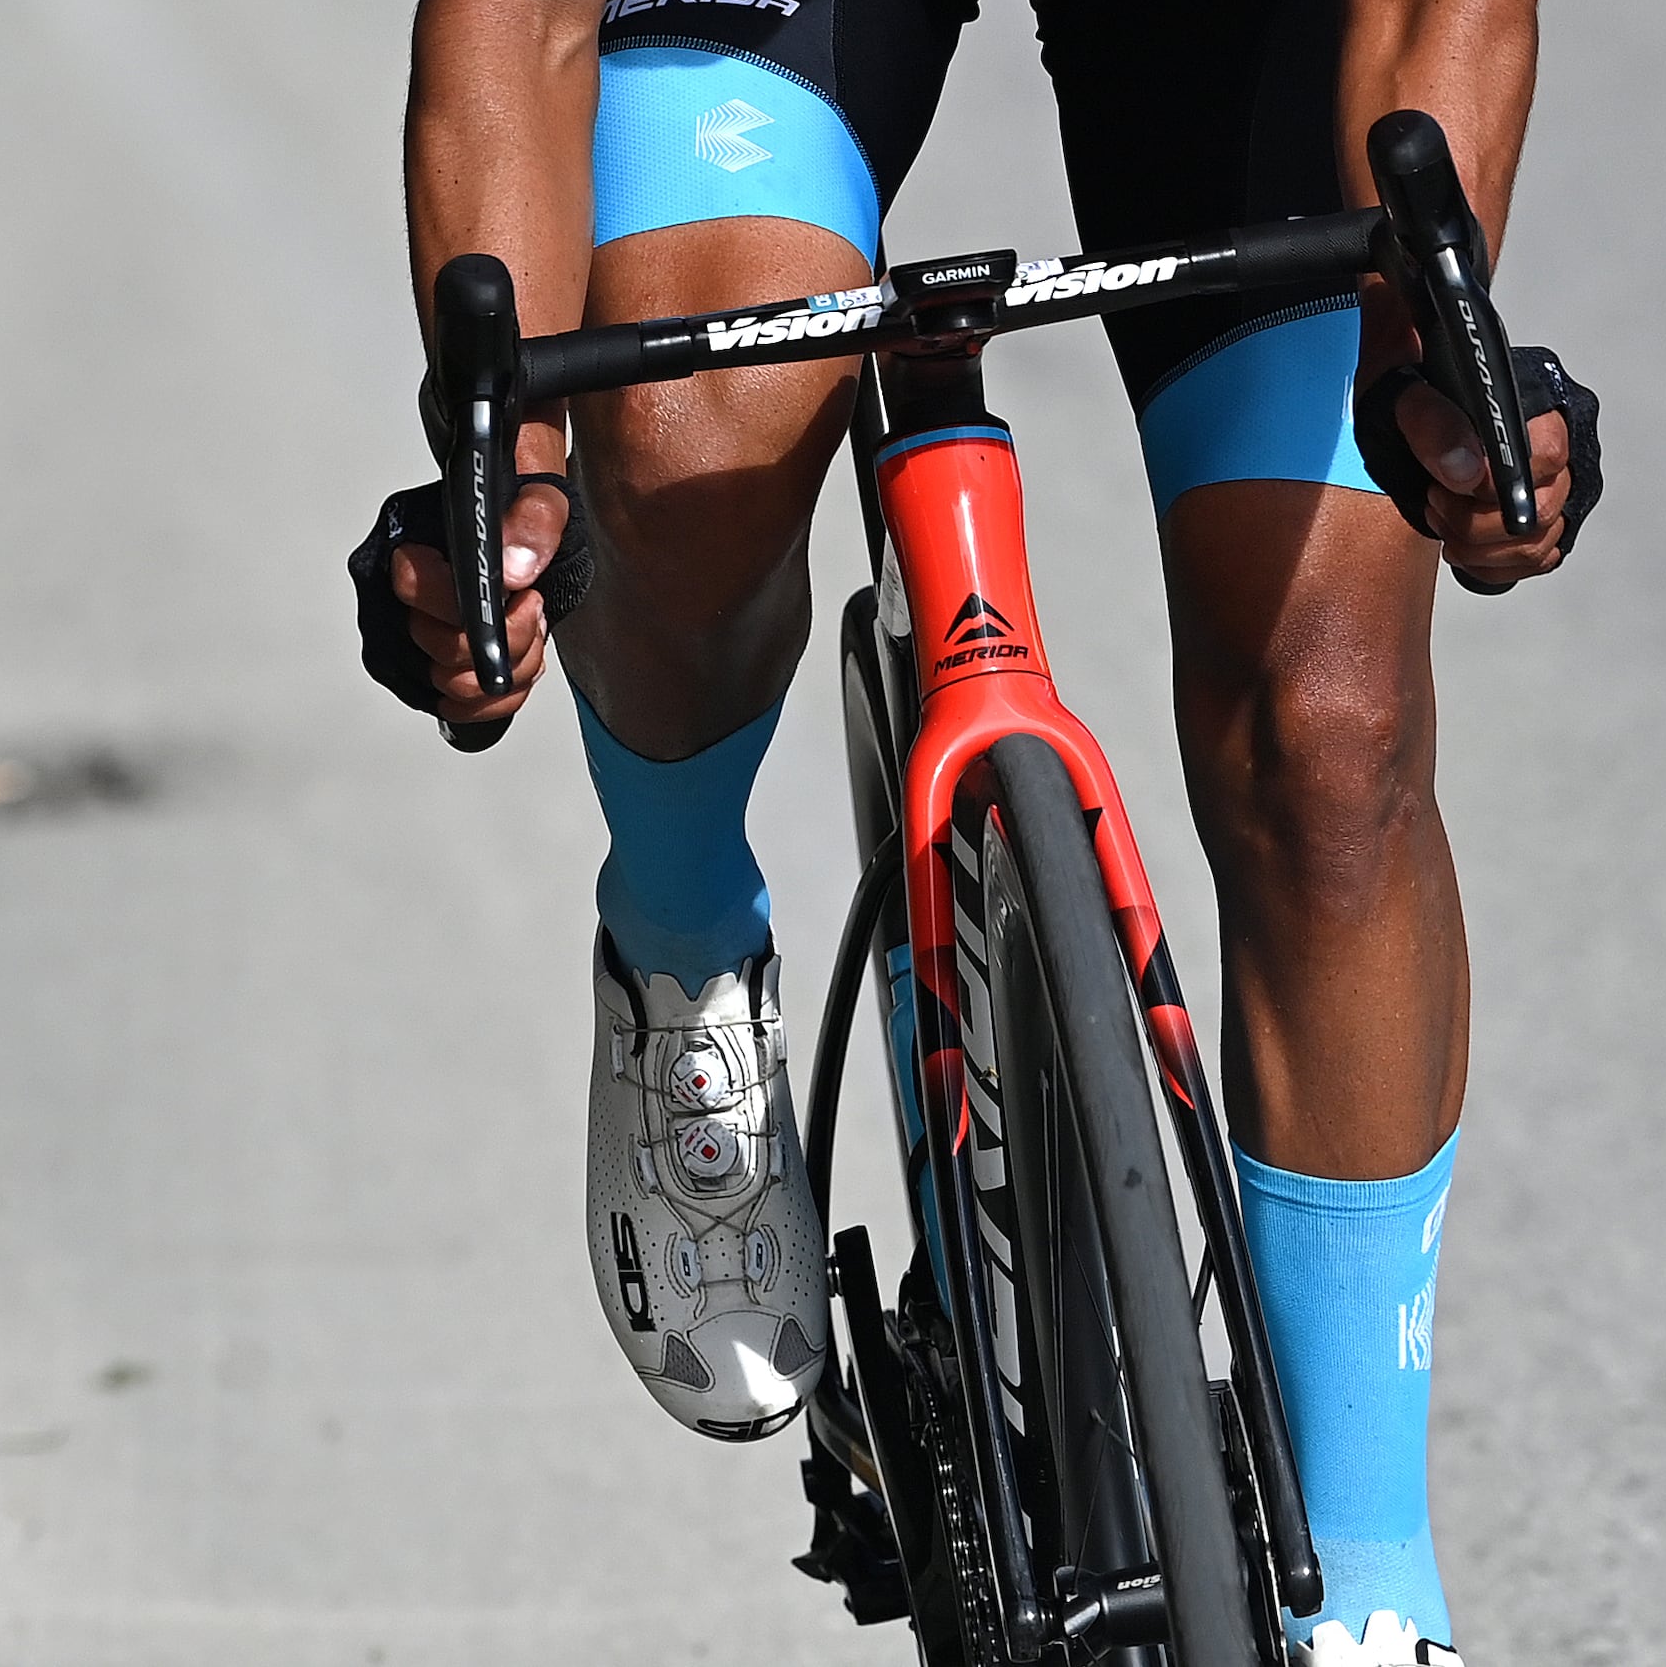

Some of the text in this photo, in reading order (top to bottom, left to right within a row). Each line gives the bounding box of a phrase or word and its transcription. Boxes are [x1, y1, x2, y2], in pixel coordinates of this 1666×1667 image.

[921, 264, 991, 285] GARMIN
[1457, 299, 1514, 468] DURA-ACE
[472, 449, 494, 626] DURA-ACE
[934, 644, 1029, 677] MERIDA
[1117, 1573, 1162, 1590] sion
